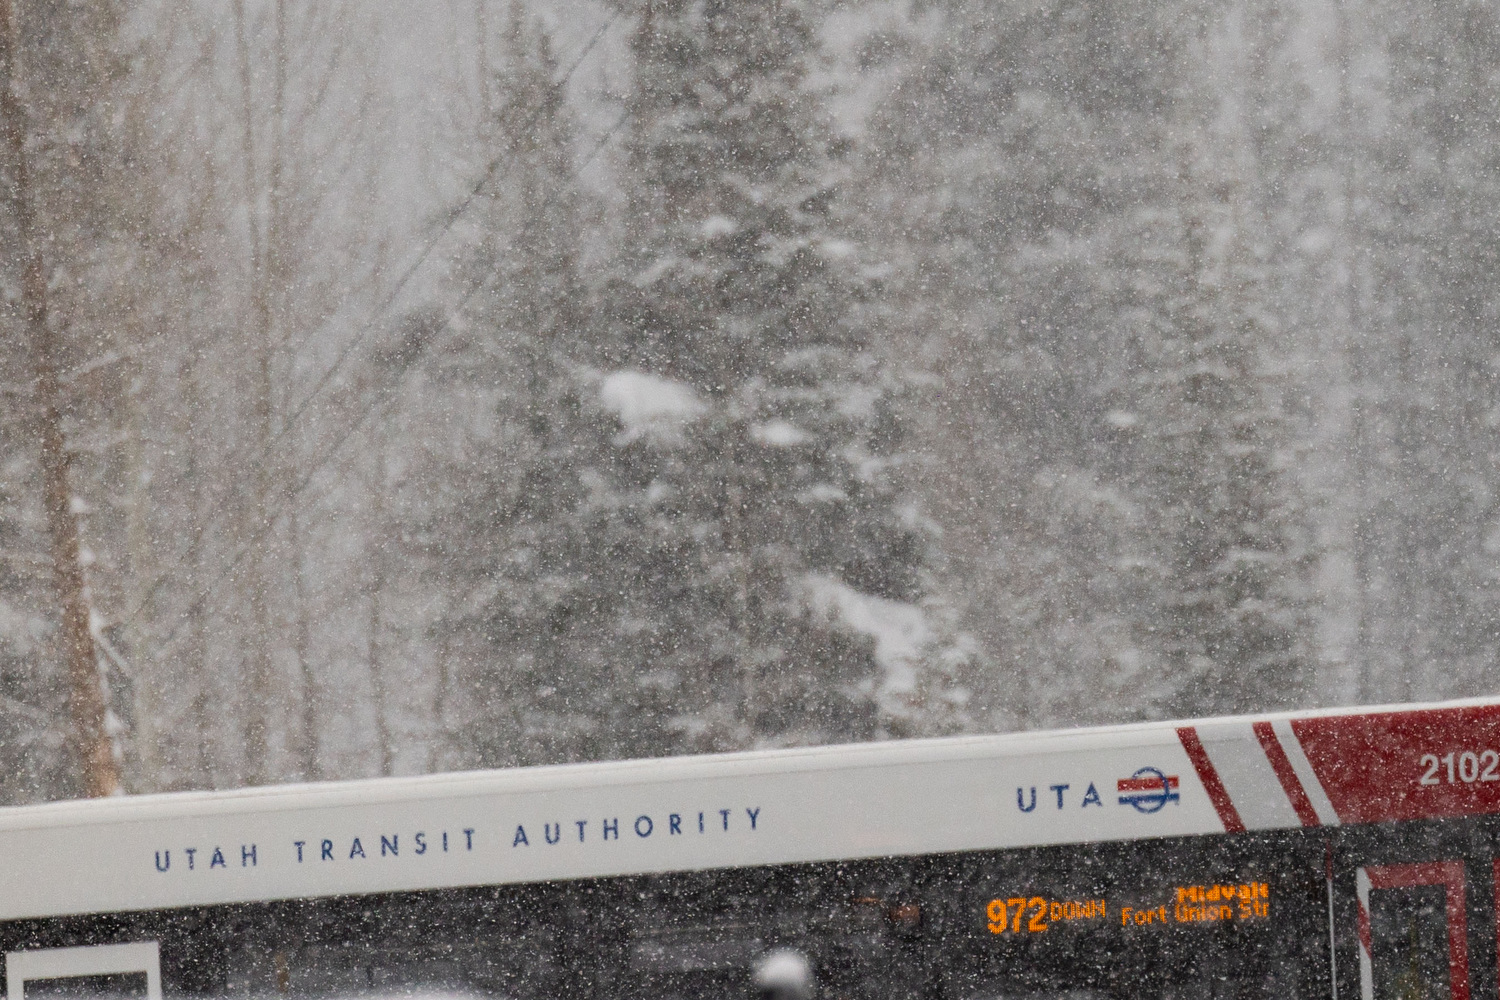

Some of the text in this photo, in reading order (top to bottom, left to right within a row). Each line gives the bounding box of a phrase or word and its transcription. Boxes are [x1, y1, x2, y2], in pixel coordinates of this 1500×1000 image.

[1017, 781, 1103, 813] UTA
[155, 806, 760, 872] UTAH TRANSIT AUTHORITY
[987, 896, 1106, 934] 972 DOWN
[1121, 904, 1167, 926] Fort
[1175, 902, 1232, 923] Union
